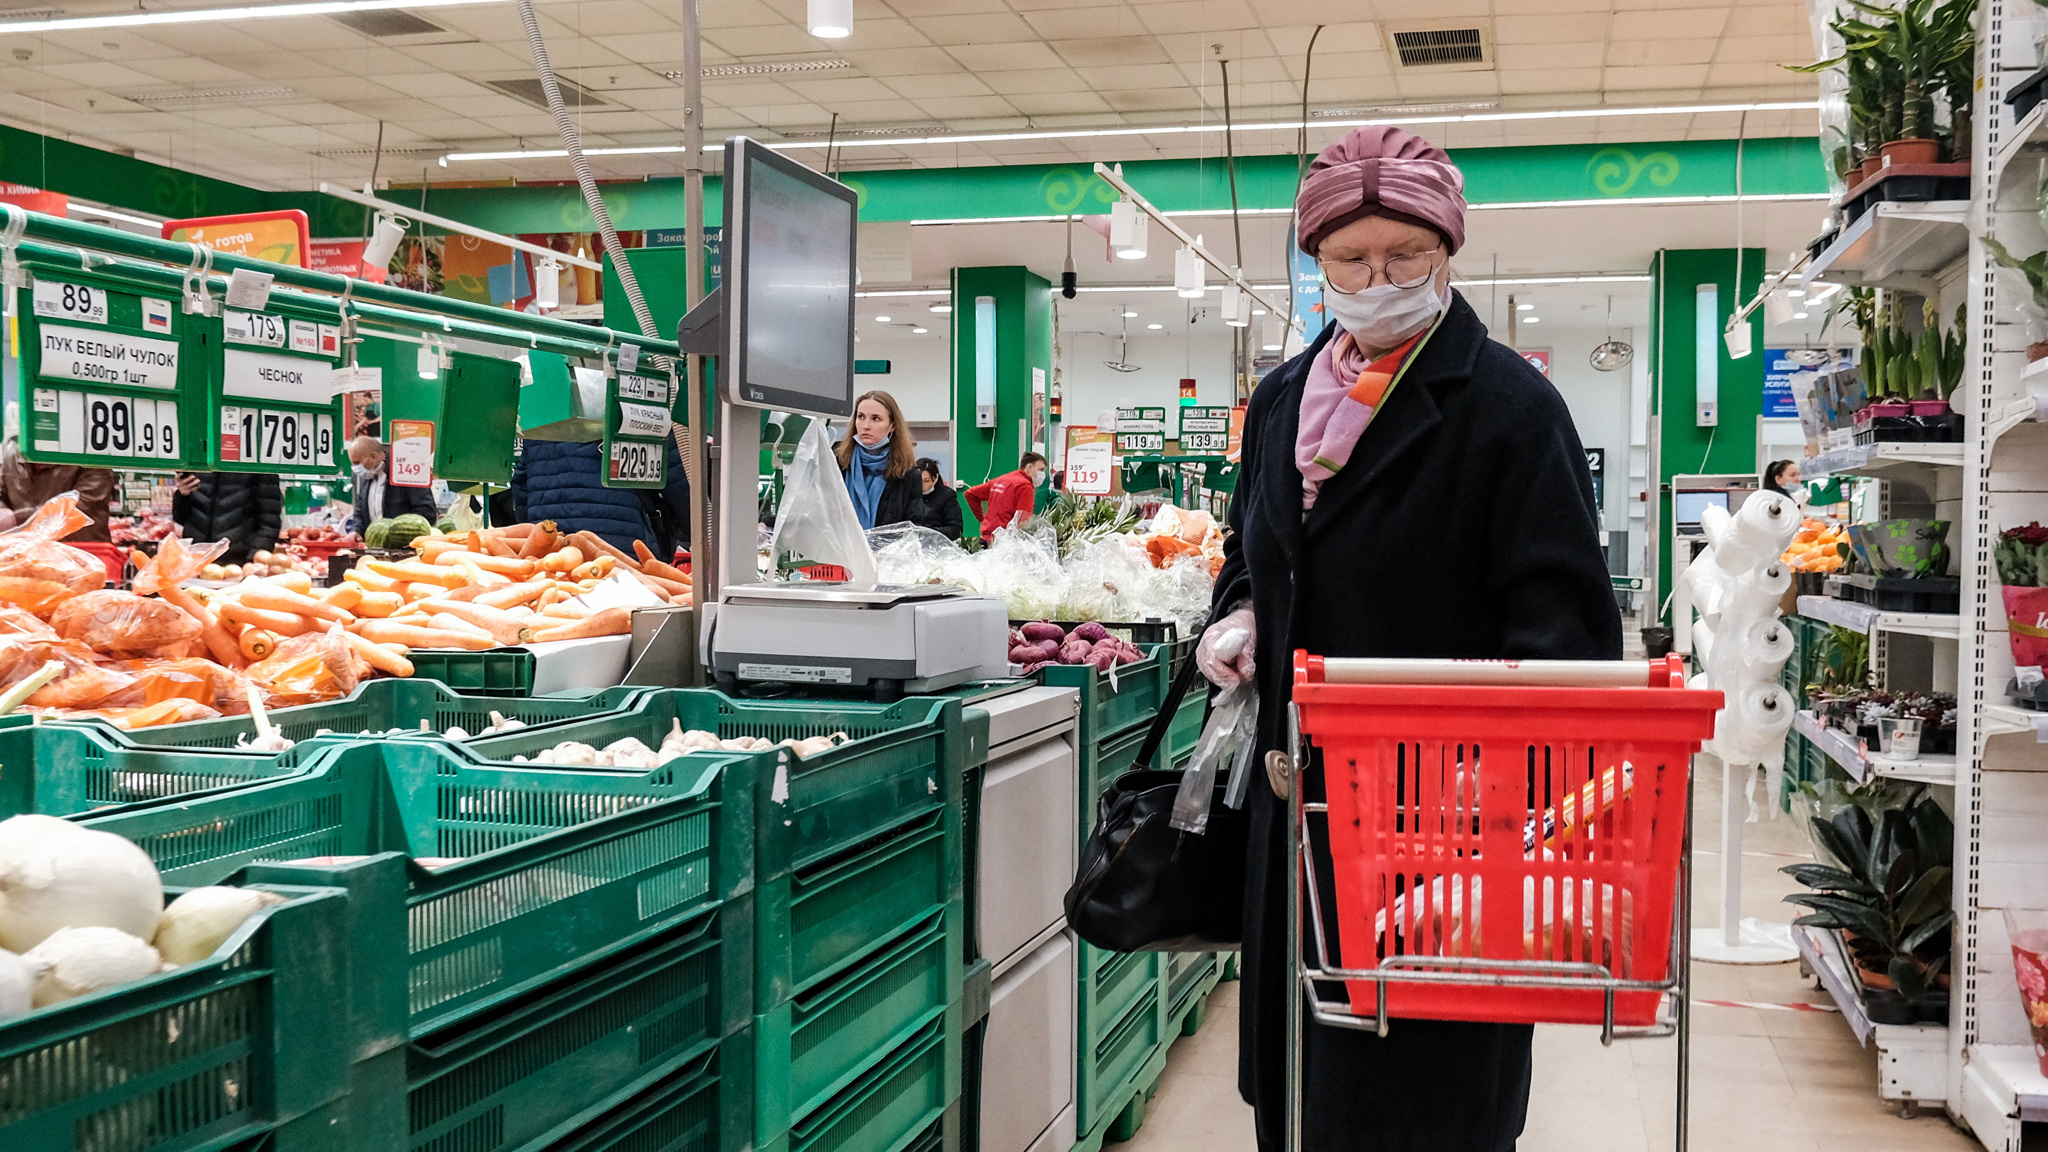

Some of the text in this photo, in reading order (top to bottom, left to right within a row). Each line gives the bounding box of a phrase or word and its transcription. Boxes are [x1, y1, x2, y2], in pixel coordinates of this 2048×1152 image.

[215, 232, 253, 248] готов
[310, 248, 341, 257] МЕТИКА
[62, 284, 92, 314] 89
[248, 313, 277, 341] 179
[45, 335, 175, 368] ЛУК БЕЛЫЙ ЧУЛОК
[72, 361, 148, 385] 0,500гр 1шт
[258, 366, 303, 384] ЧЕСНОК
[1181, 389, 1193, 397] 14
[398, 463, 421, 475] 149
[1587, 452, 1600, 471] 2
[1072, 471, 1099, 483] 119
